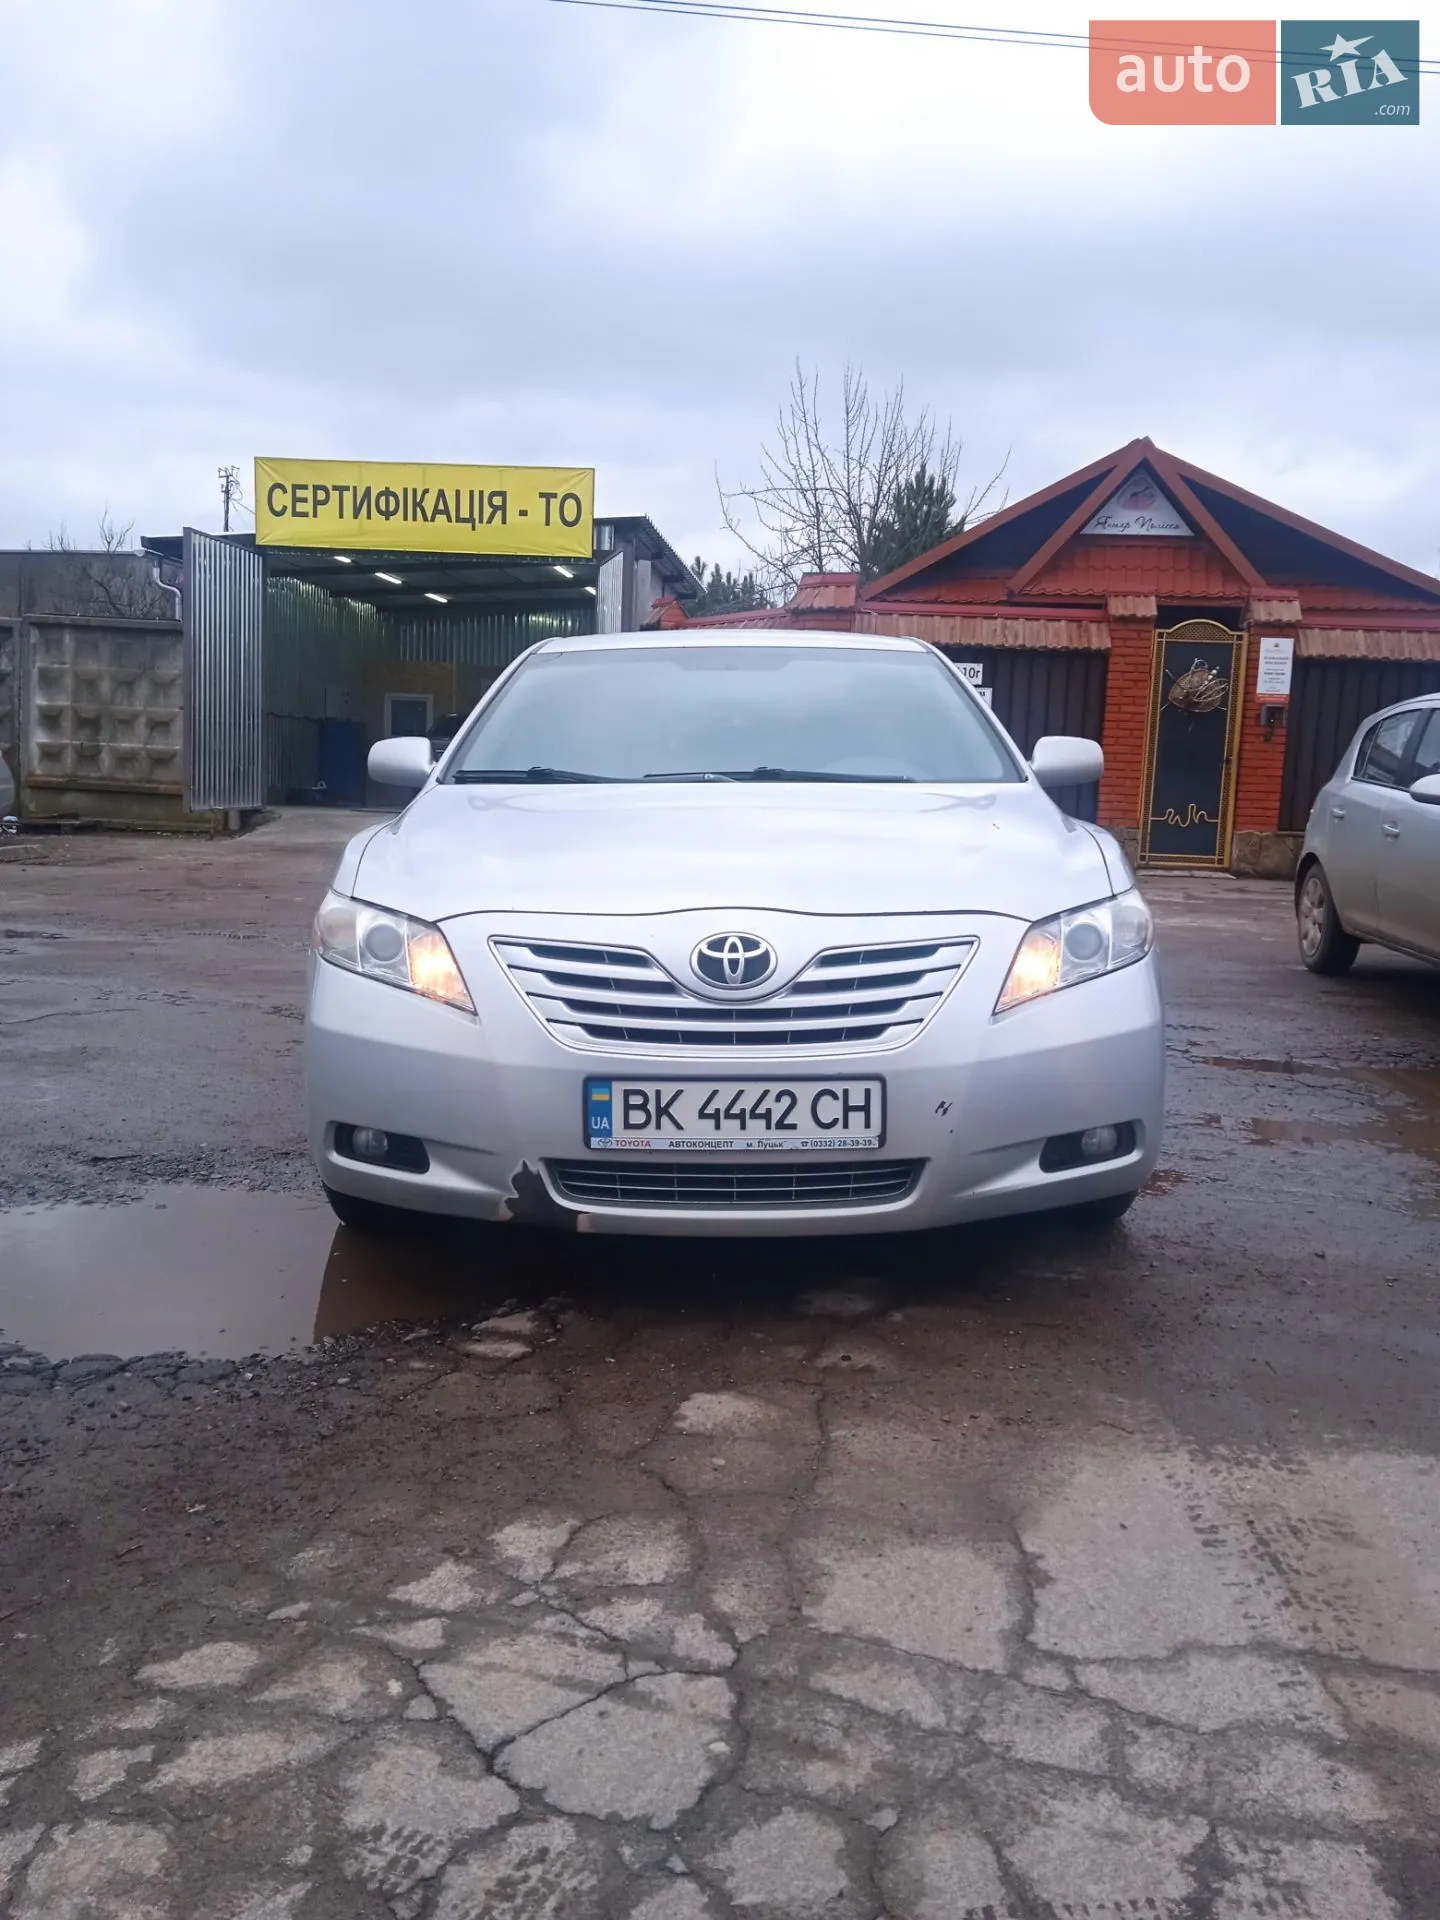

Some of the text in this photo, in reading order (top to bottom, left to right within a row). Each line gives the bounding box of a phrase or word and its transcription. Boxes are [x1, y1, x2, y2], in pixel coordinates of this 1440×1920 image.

[266, 482, 583, 531] СЕРТИФІКАЦІЯ - ТО
[959, 666, 981, 679] 10г
[622, 1087, 872, 1131] BK 4442 CH
[591, 1117, 610, 1129] UA
[614, 1139, 652, 1148] TOYOTA
[668, 1140, 734, 1149] АВТОКОНЦЕПТ
[810, 1139, 836, 1148] (0332)
